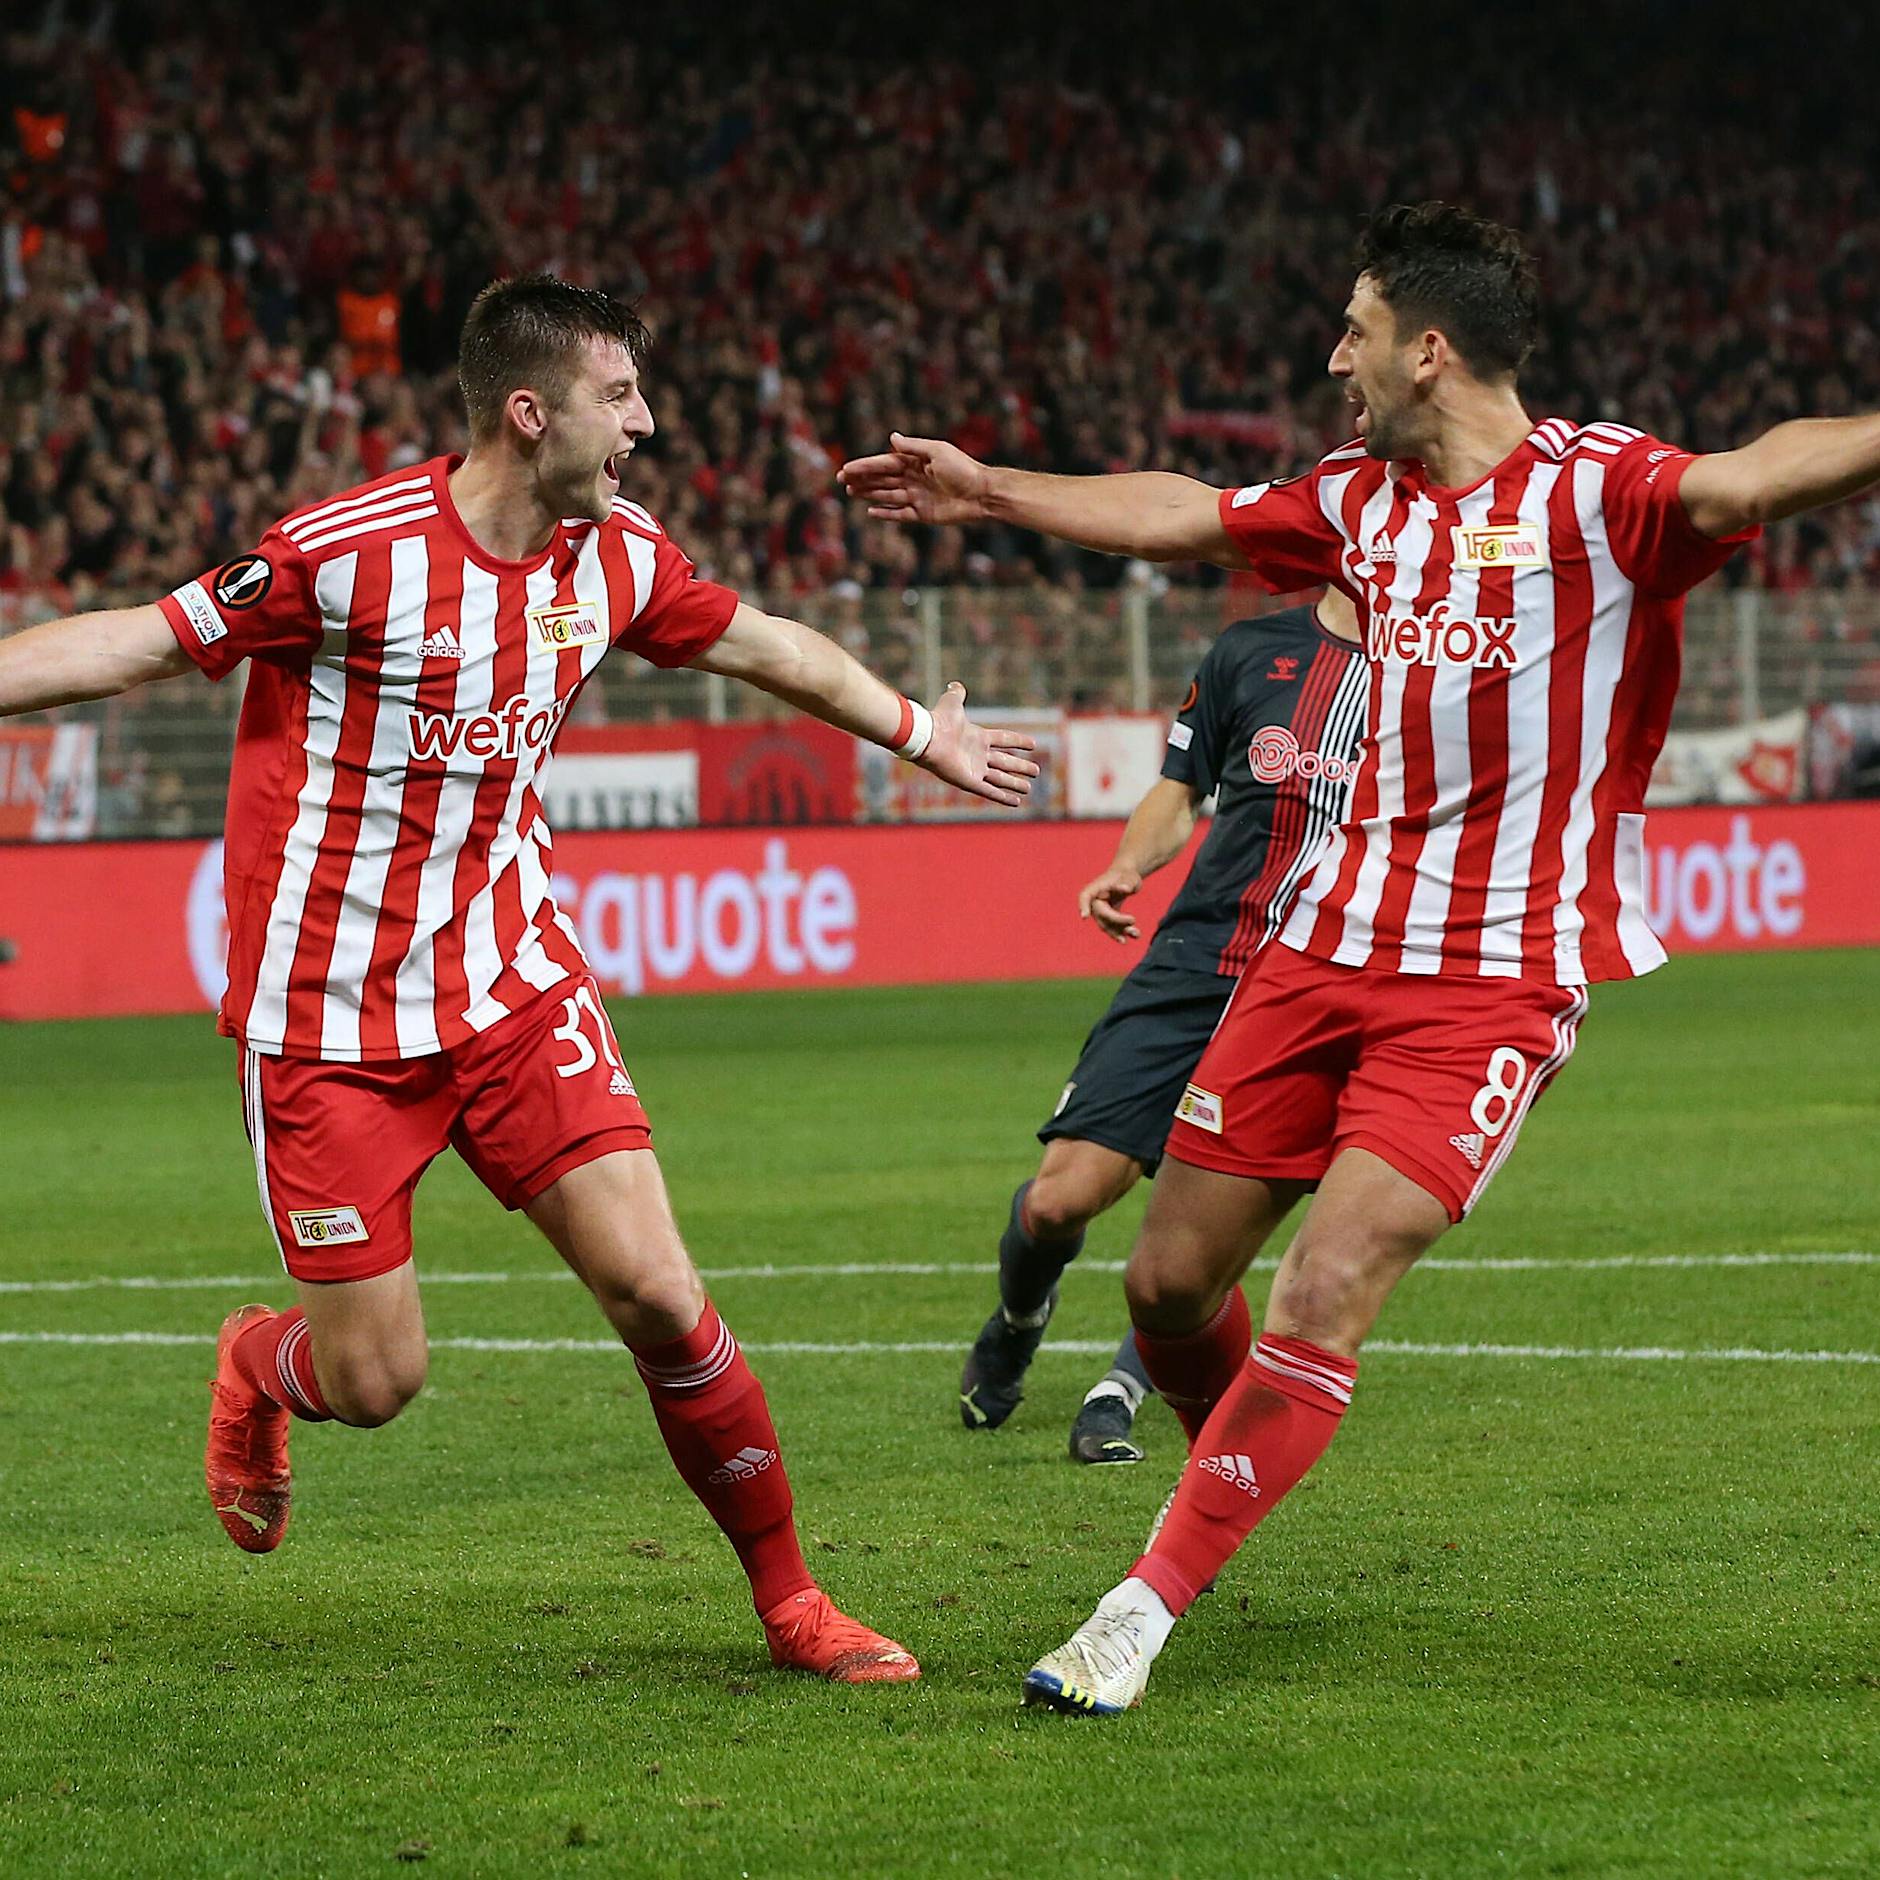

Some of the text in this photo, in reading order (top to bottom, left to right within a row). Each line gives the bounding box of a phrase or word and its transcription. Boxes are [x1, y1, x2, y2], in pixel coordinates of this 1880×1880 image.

[569, 618, 598, 637] UNION
[1371, 604, 1518, 664] wefox
[417, 645, 466, 659] adidas
[552, 985, 620, 1078] 31
[1470, 1047, 1527, 1137] 8
[326, 1221, 357, 1236] UNION
[708, 1450, 777, 1484] adidas
[1198, 1457, 1261, 1498] adidas
